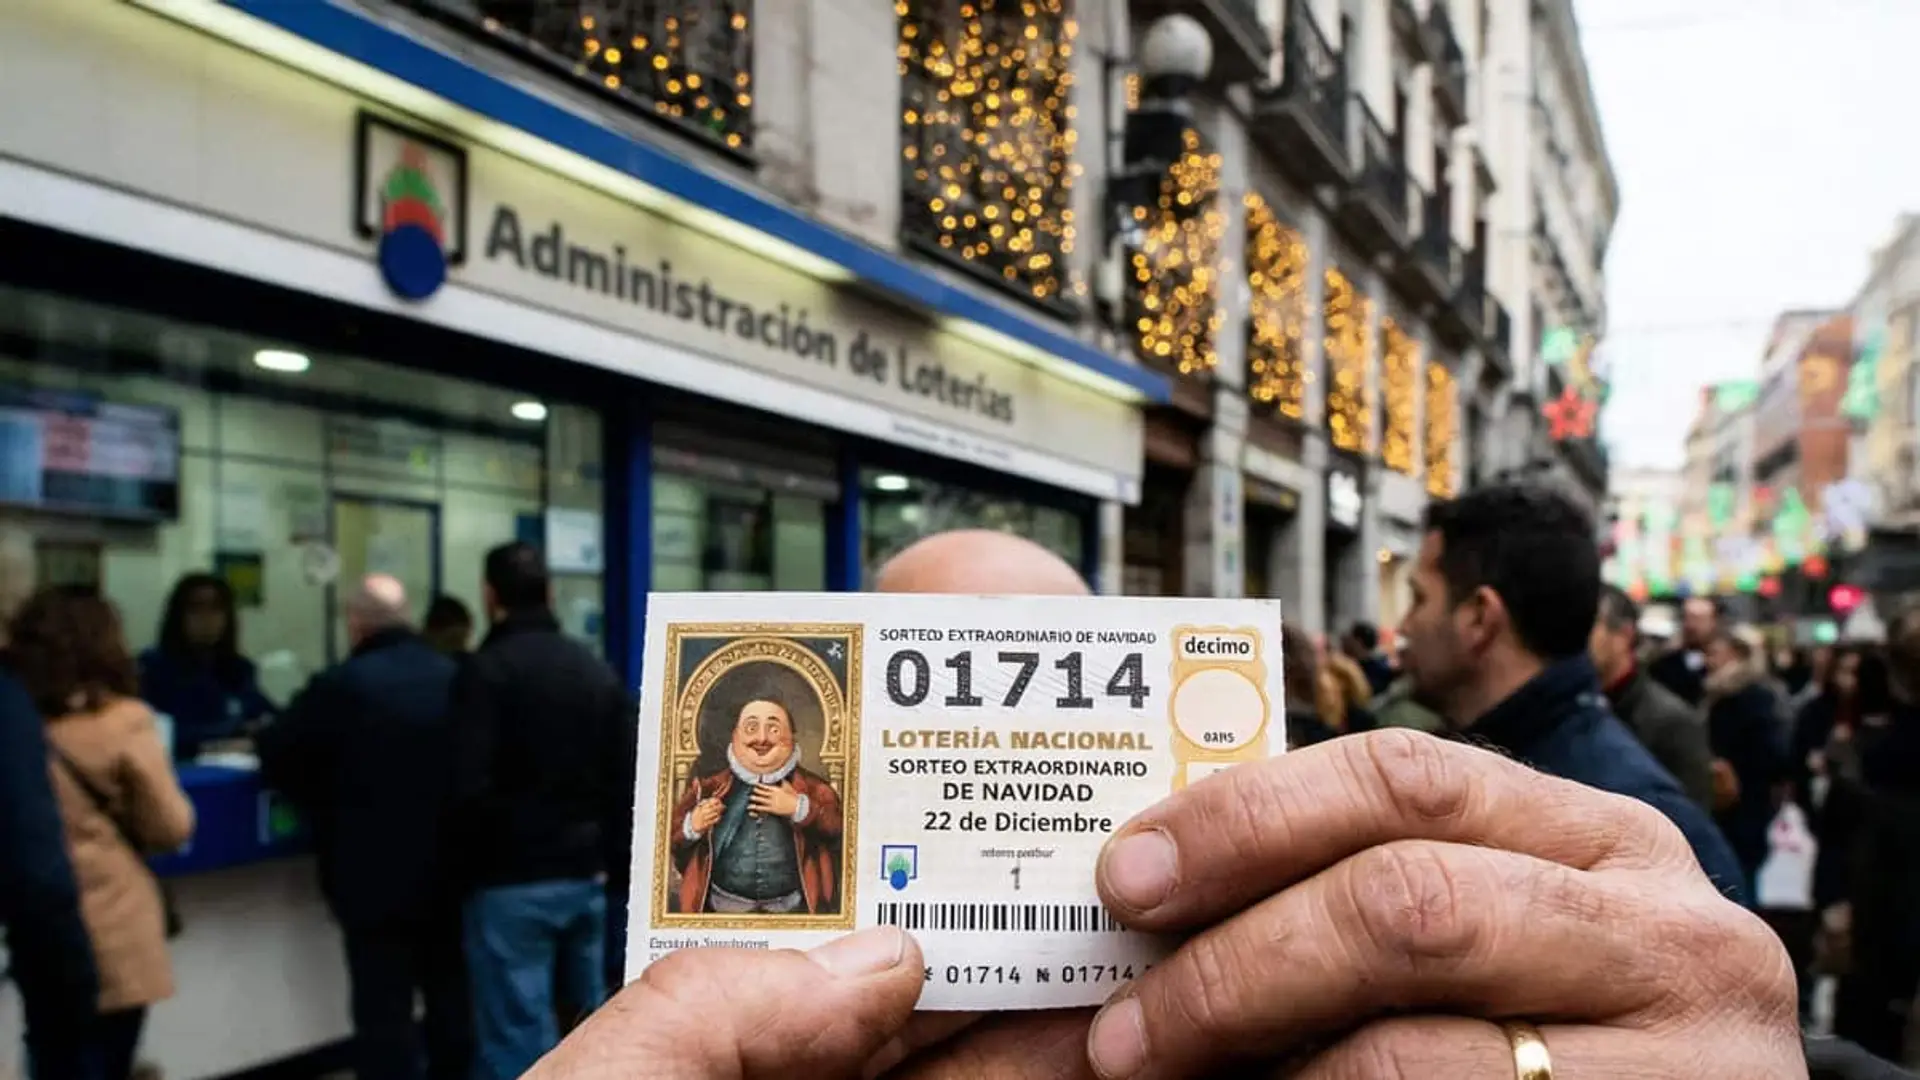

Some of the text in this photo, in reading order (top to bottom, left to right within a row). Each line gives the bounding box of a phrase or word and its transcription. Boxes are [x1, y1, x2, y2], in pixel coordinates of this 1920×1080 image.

[485, 205, 1015, 424] Administración de Loterías
[1075, 632, 1093, 643] DE
[1097, 632, 1157, 645] NAVIDAD
[1185, 636, 1250, 654] decimo
[886, 649, 1151, 709] 01714
[1011, 731, 1153, 751] NACIONAL
[888, 758, 1148, 777] SORTEO EXTRAORDINARIO
[943, 782, 1093, 802] DE NAVIDAD
[924, 811, 1112, 833] 22 de Diciembre
[1010, 866, 1021, 890] 1
[946, 965, 1021, 984] 01714
[1062, 965, 1134, 983] 01714
